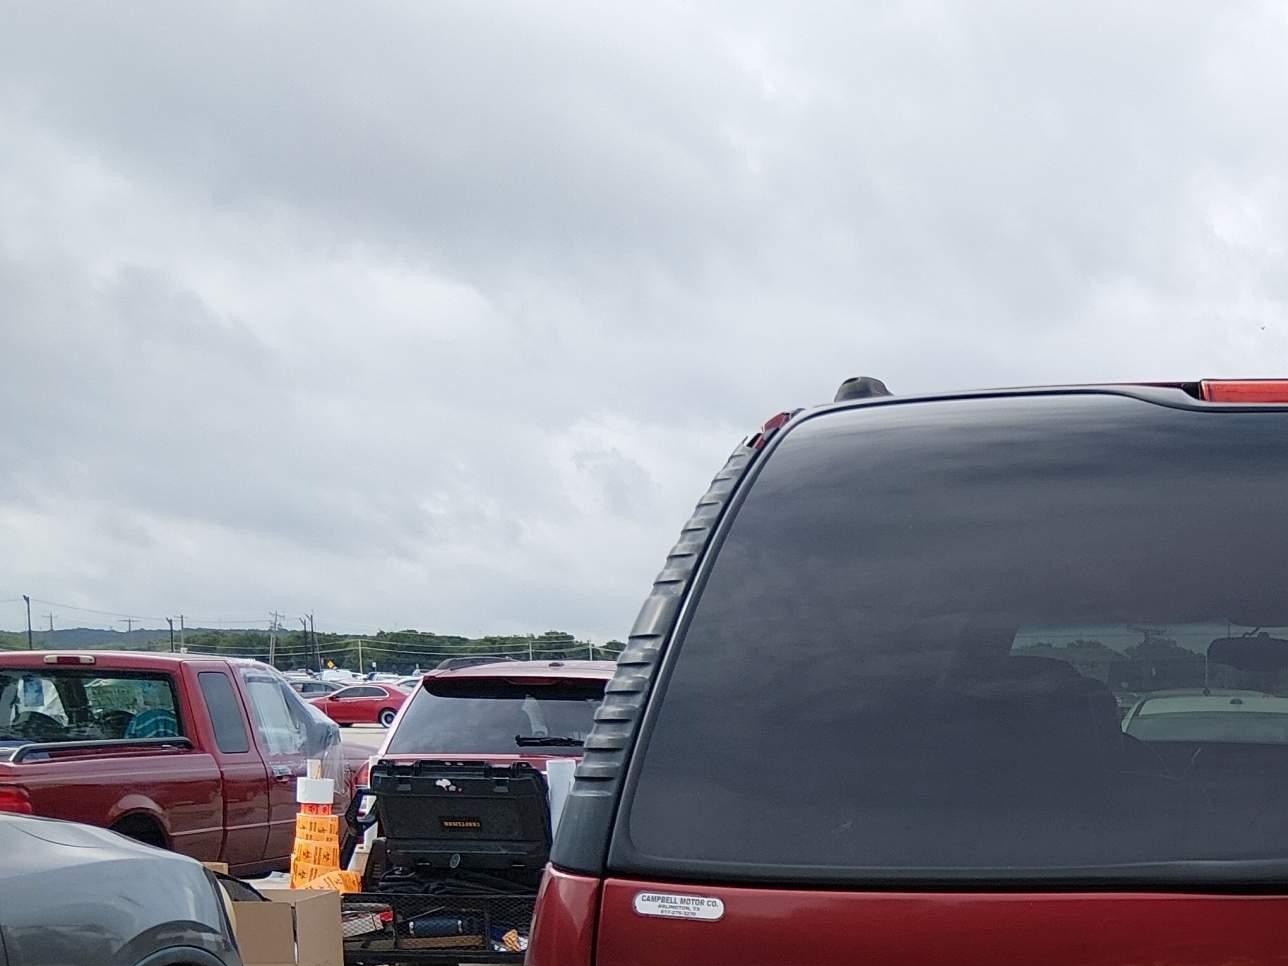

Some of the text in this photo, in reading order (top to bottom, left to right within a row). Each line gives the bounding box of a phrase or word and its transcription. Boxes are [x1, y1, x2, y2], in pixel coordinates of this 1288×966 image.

[641, 894, 719, 908] CAMPBELL MOTOR CO.
